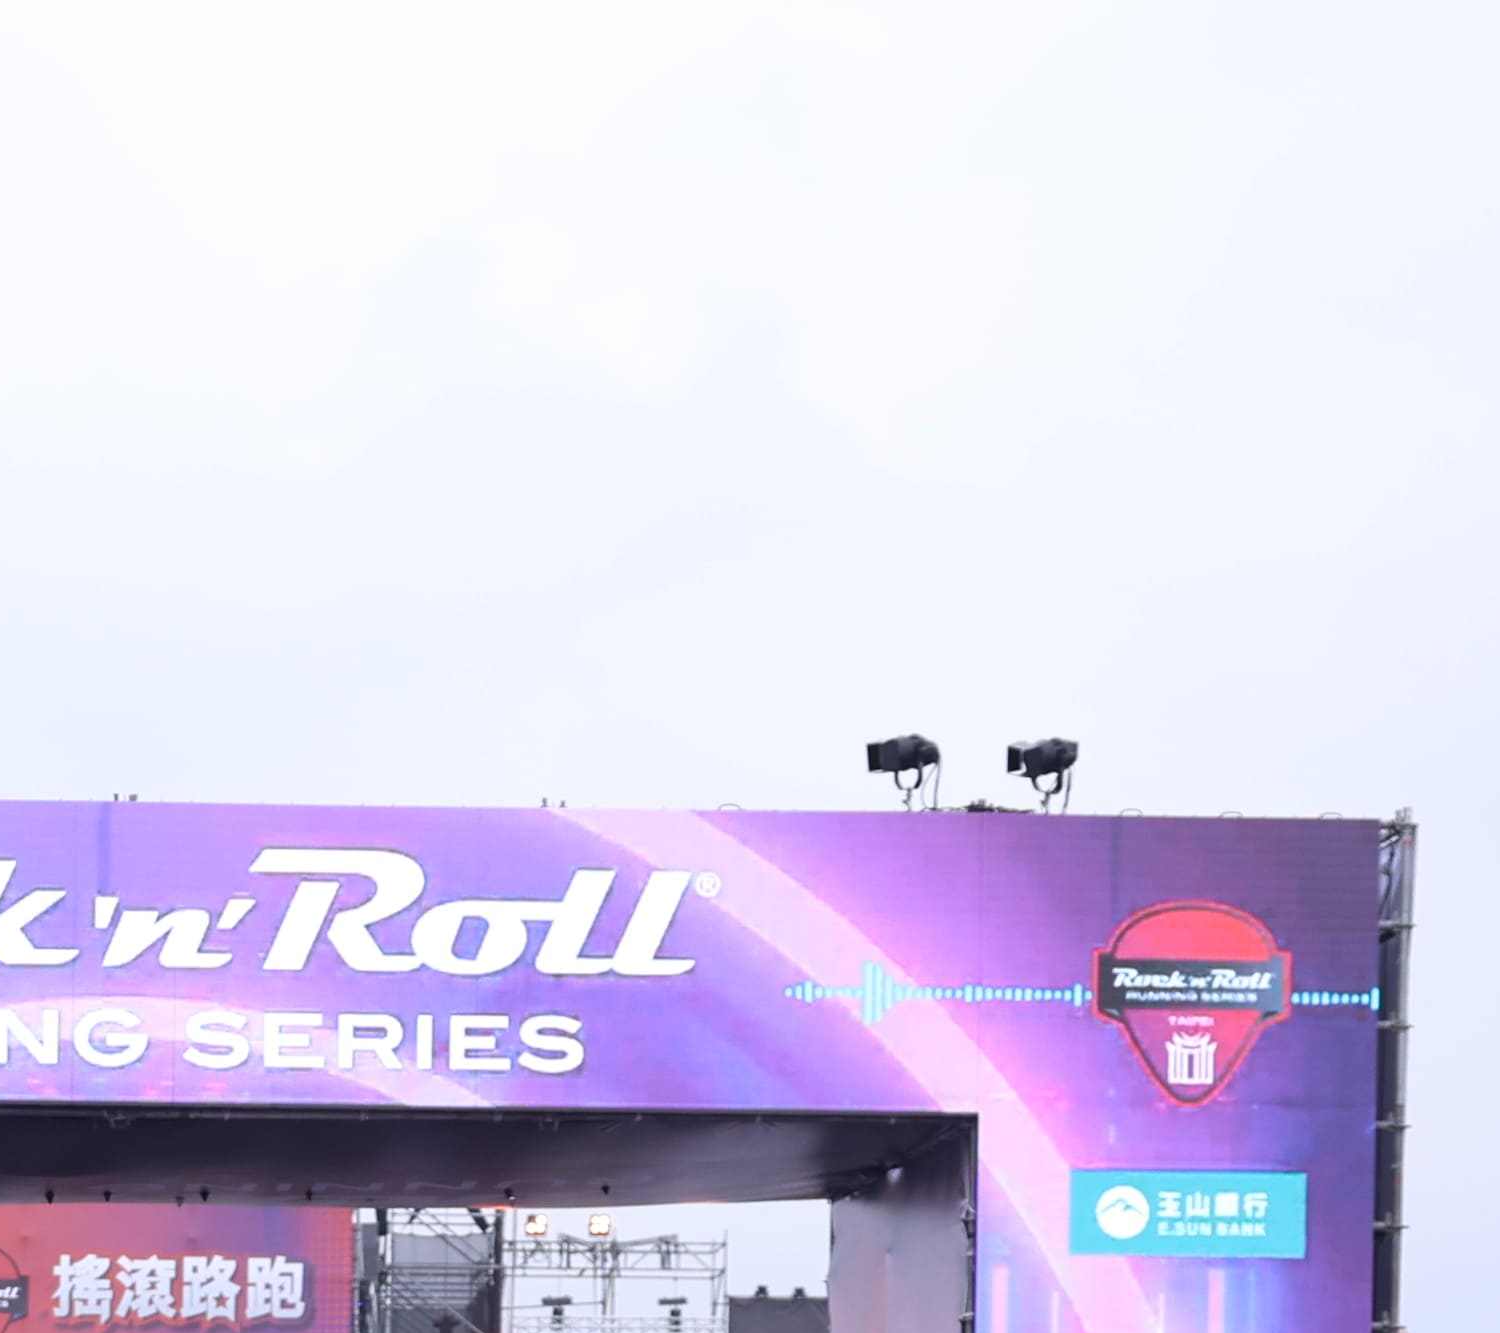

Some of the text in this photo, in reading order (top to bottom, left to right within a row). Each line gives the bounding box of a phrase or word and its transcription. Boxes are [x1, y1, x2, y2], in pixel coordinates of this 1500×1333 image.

[248, 847, 696, 976] Roll
[1112, 967, 1185, 989] Rock
[1210, 968, 1272, 990] Roll
[183, 1011, 585, 1075] SERIES
[1215, 1222, 1267, 1237] BANK
[53, 1254, 306, 1320] 搖滾路跑
